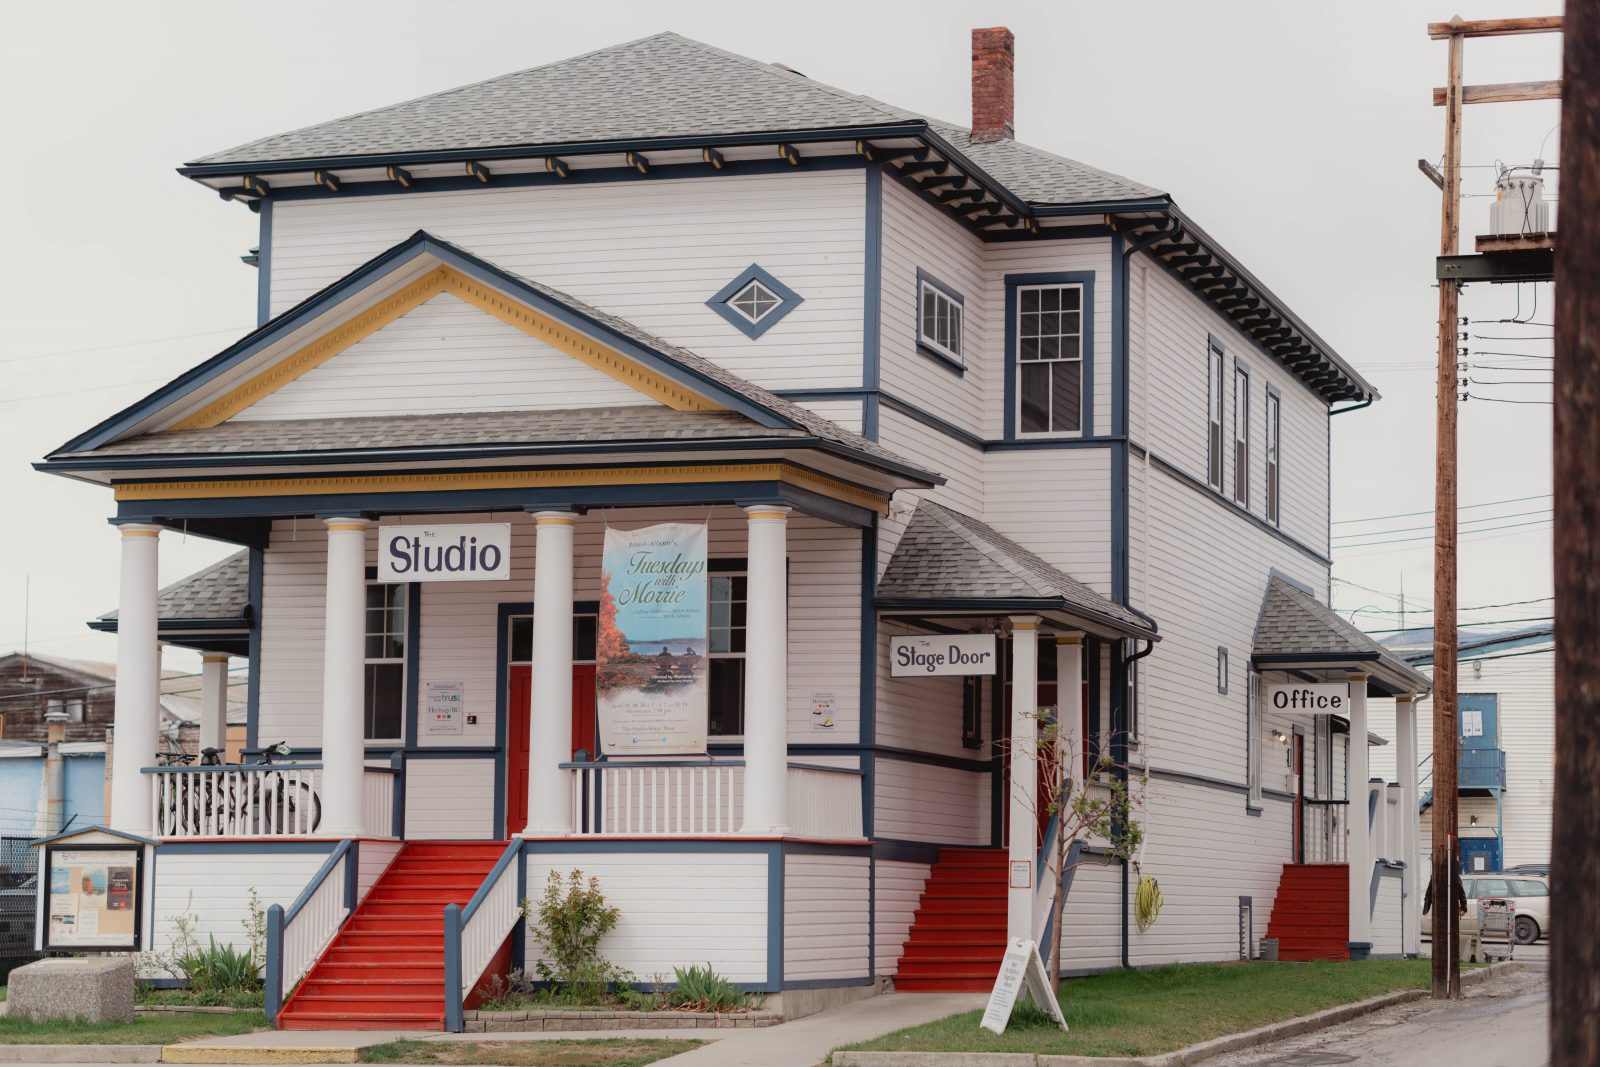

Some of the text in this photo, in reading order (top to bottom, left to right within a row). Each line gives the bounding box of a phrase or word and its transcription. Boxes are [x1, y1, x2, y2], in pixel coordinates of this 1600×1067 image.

[389, 535, 502, 574] Studio
[626, 550, 705, 580] Tuesdays
[618, 580, 687, 606] Morrie
[654, 574, 676, 586] with
[897, 645, 991, 673] Stage Door
[1273, 689, 1342, 709] Office
